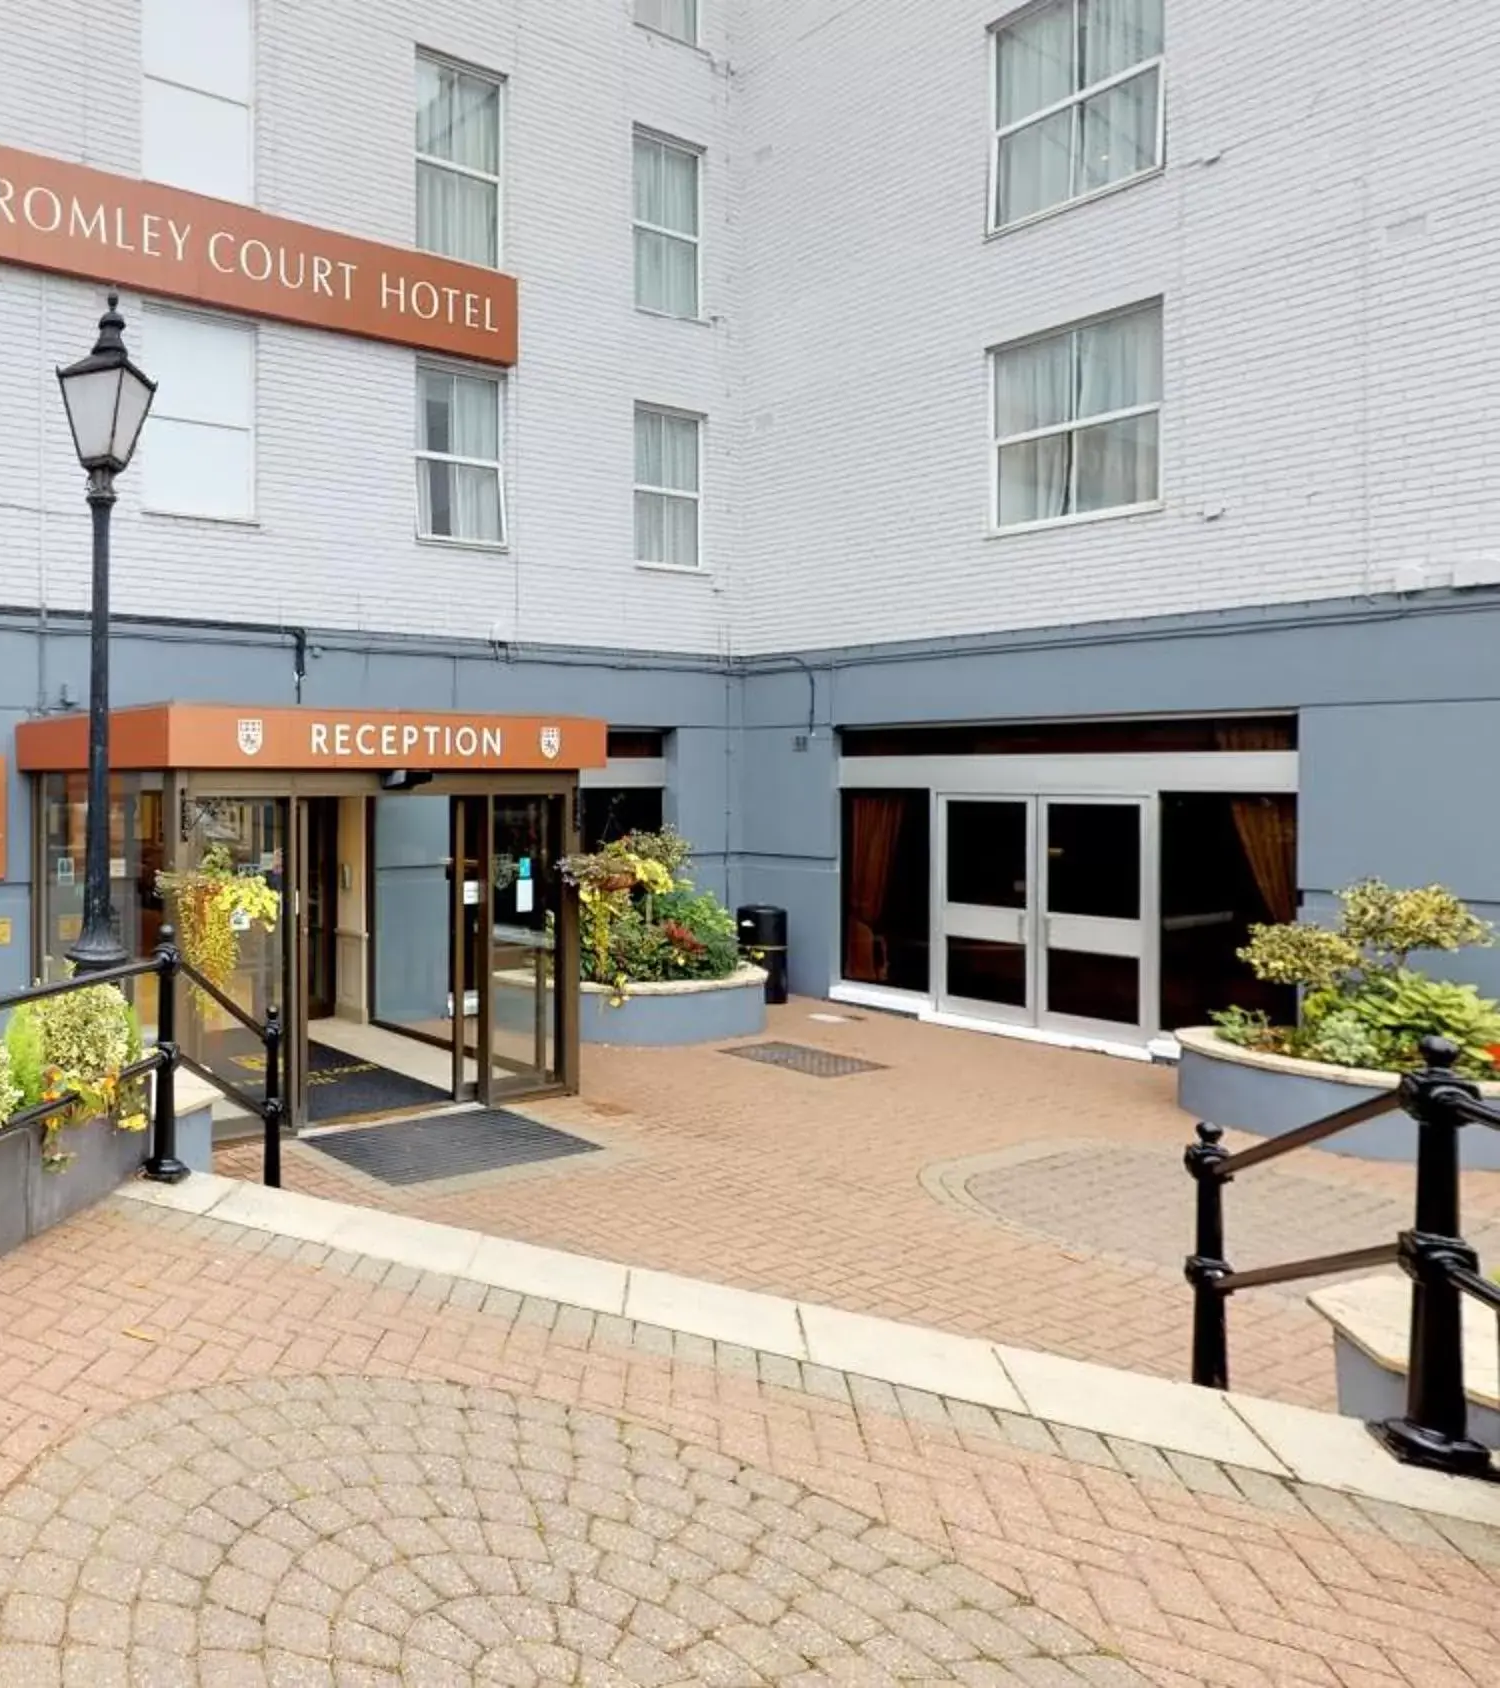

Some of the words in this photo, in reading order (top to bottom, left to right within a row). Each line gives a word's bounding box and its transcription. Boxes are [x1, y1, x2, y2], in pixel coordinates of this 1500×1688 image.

[207, 231, 358, 301] COURT
[381, 272, 499, 333] HOTEL
[310, 723, 502, 756] RECEPTION
